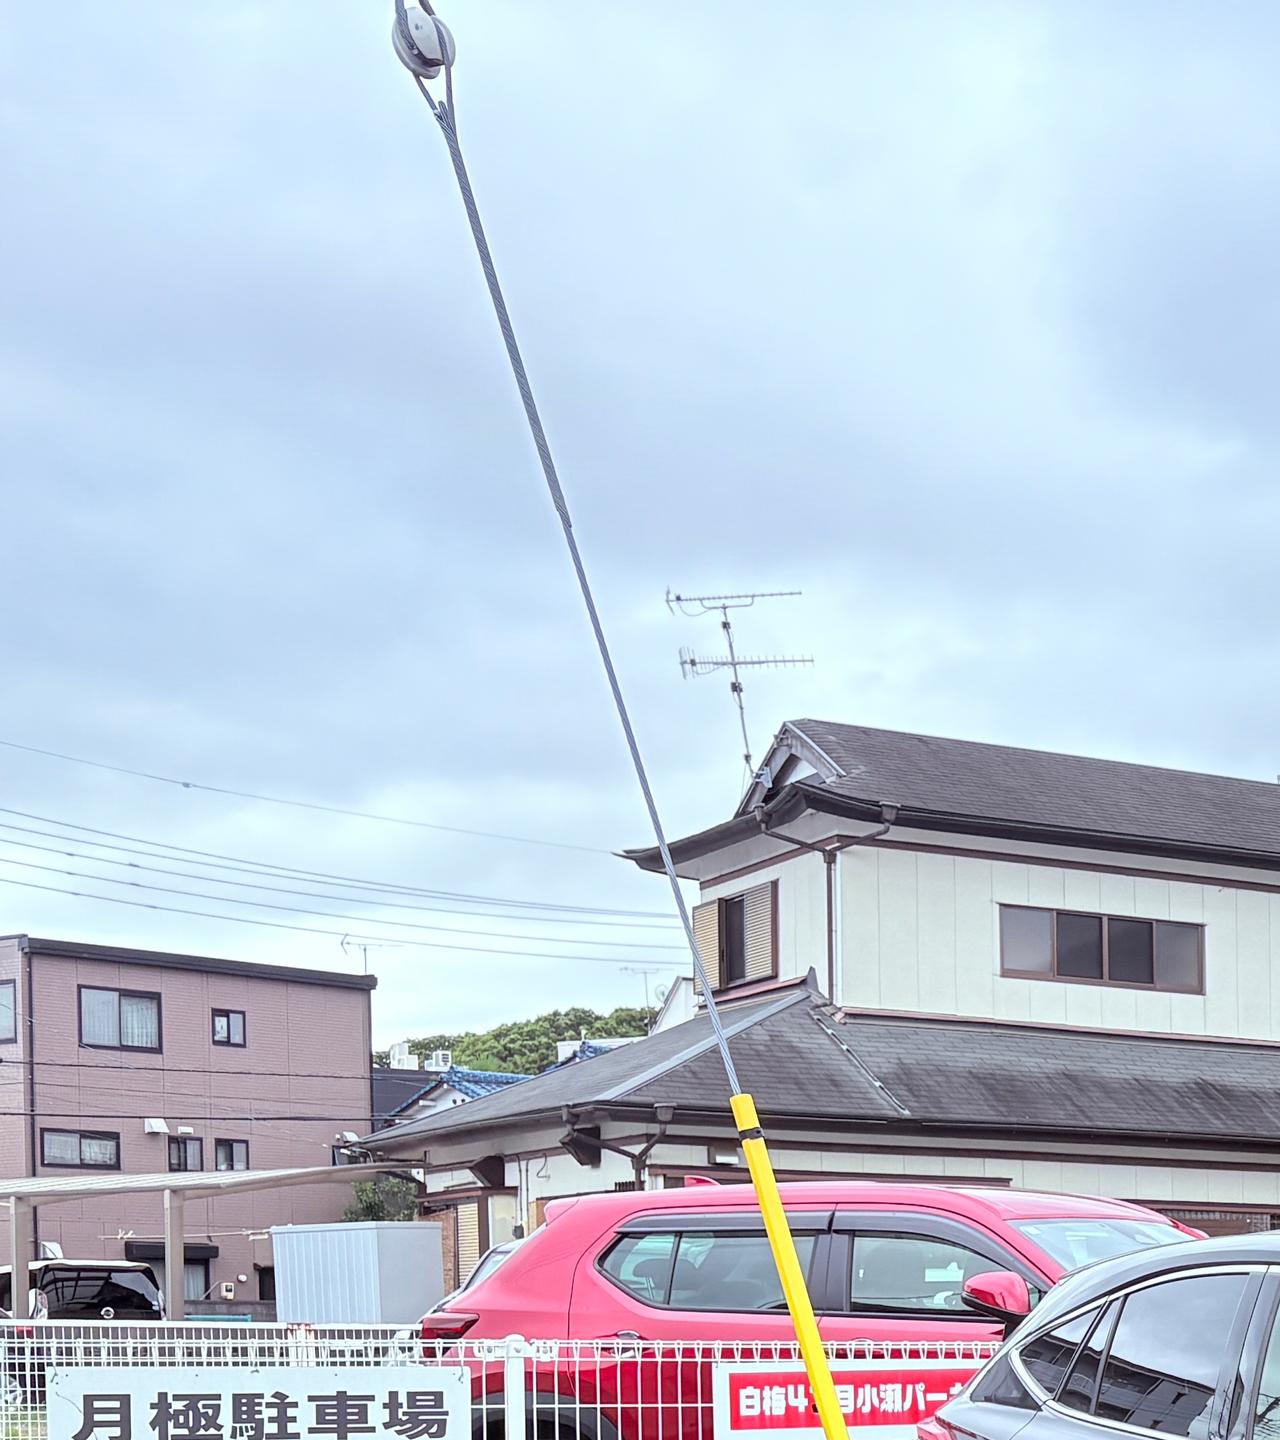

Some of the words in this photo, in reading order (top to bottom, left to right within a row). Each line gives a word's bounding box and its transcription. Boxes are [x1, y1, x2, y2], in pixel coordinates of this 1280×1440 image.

[739, 1383, 966, 1416] 白梅4目小瀬パー
